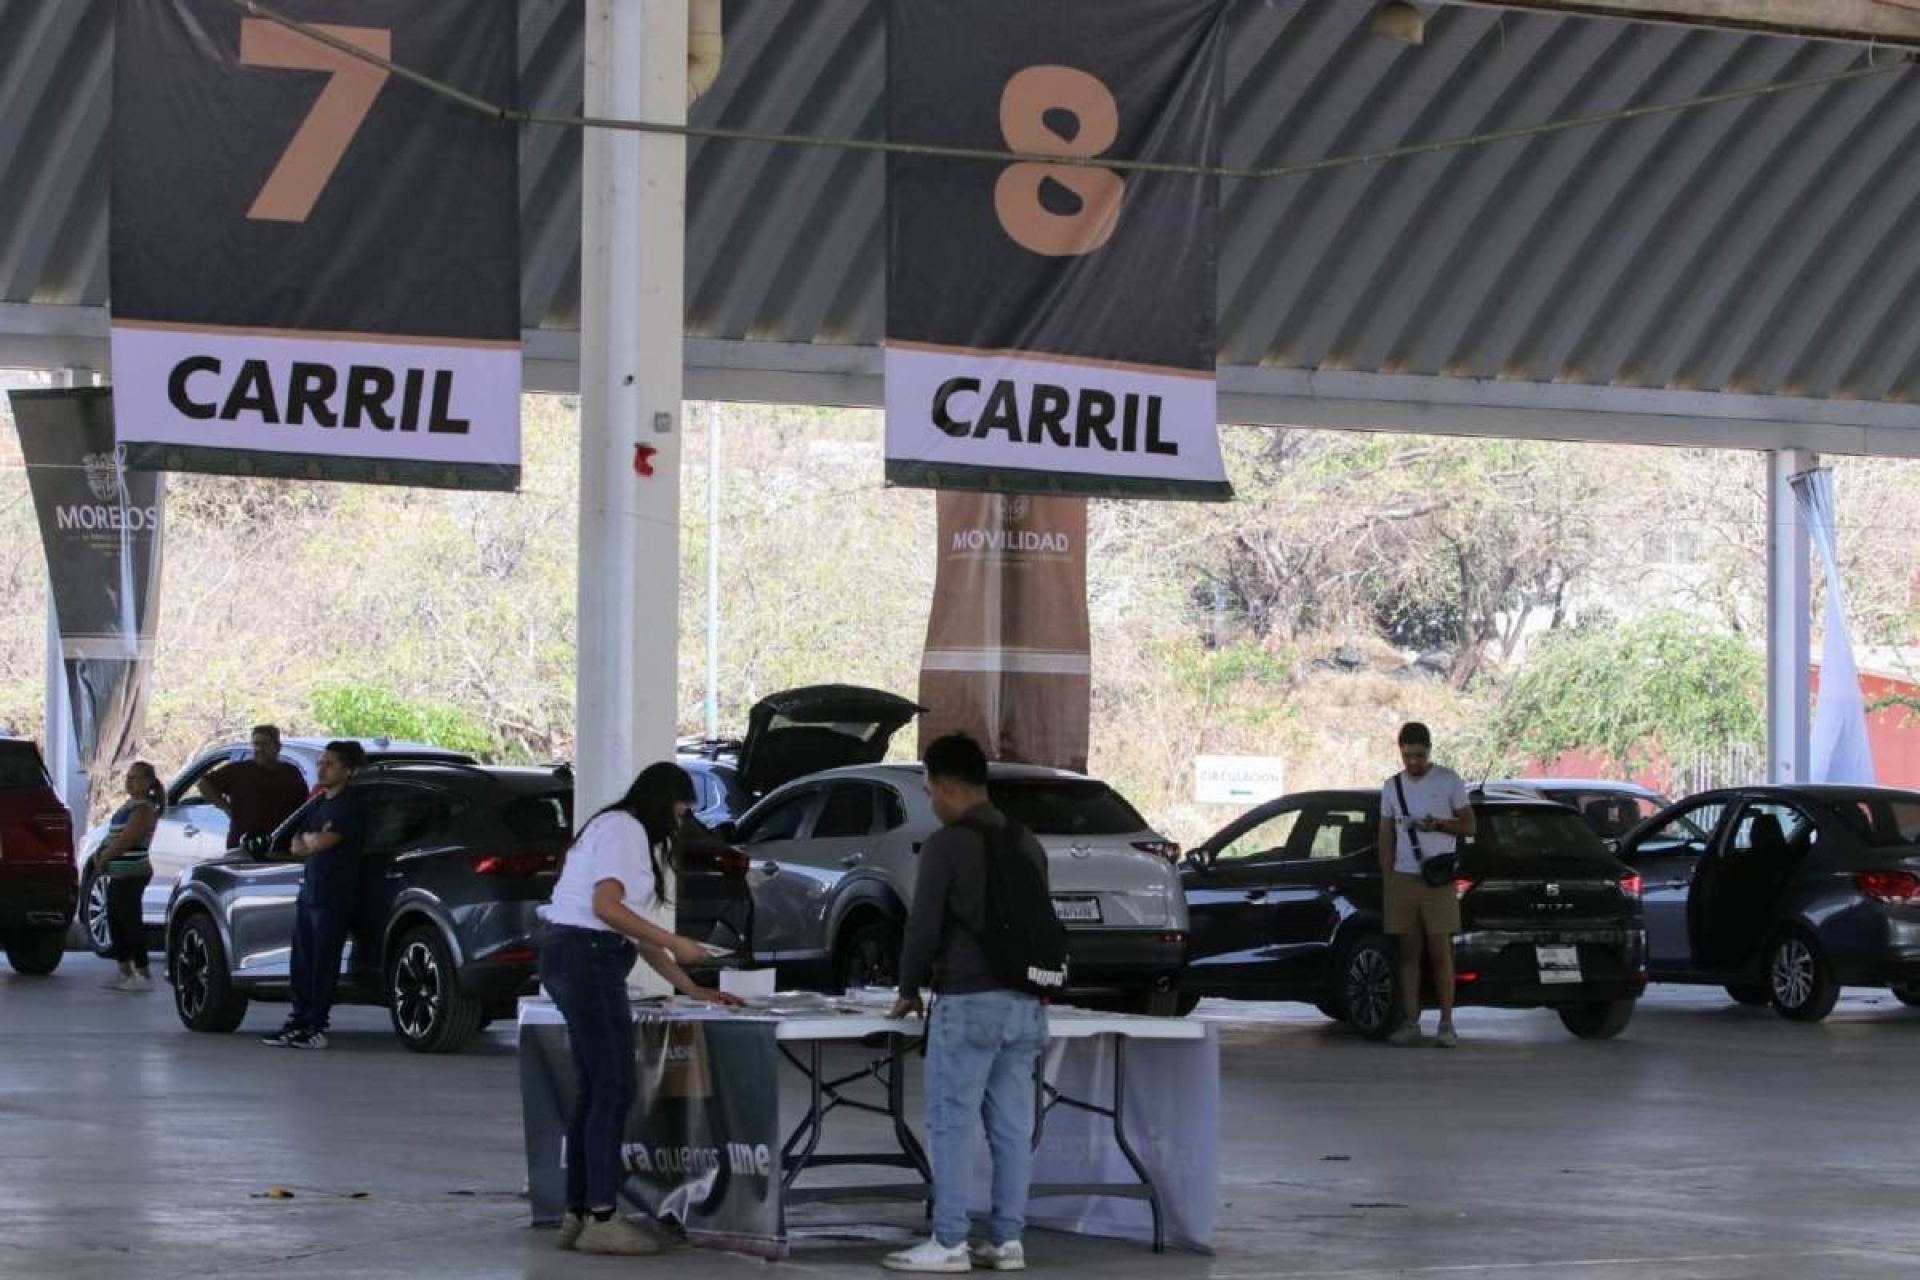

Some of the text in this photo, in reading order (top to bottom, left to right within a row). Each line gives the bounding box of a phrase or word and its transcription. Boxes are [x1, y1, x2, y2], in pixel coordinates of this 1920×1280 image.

[240, 17, 391, 222] 7
[994, 64, 1126, 257] 8
[167, 356, 470, 435] CARRIL
[931, 376, 1179, 456] CARRIL
[55, 504, 158, 531] MOREOS
[951, 529, 1070, 551] MOVILIDAD
